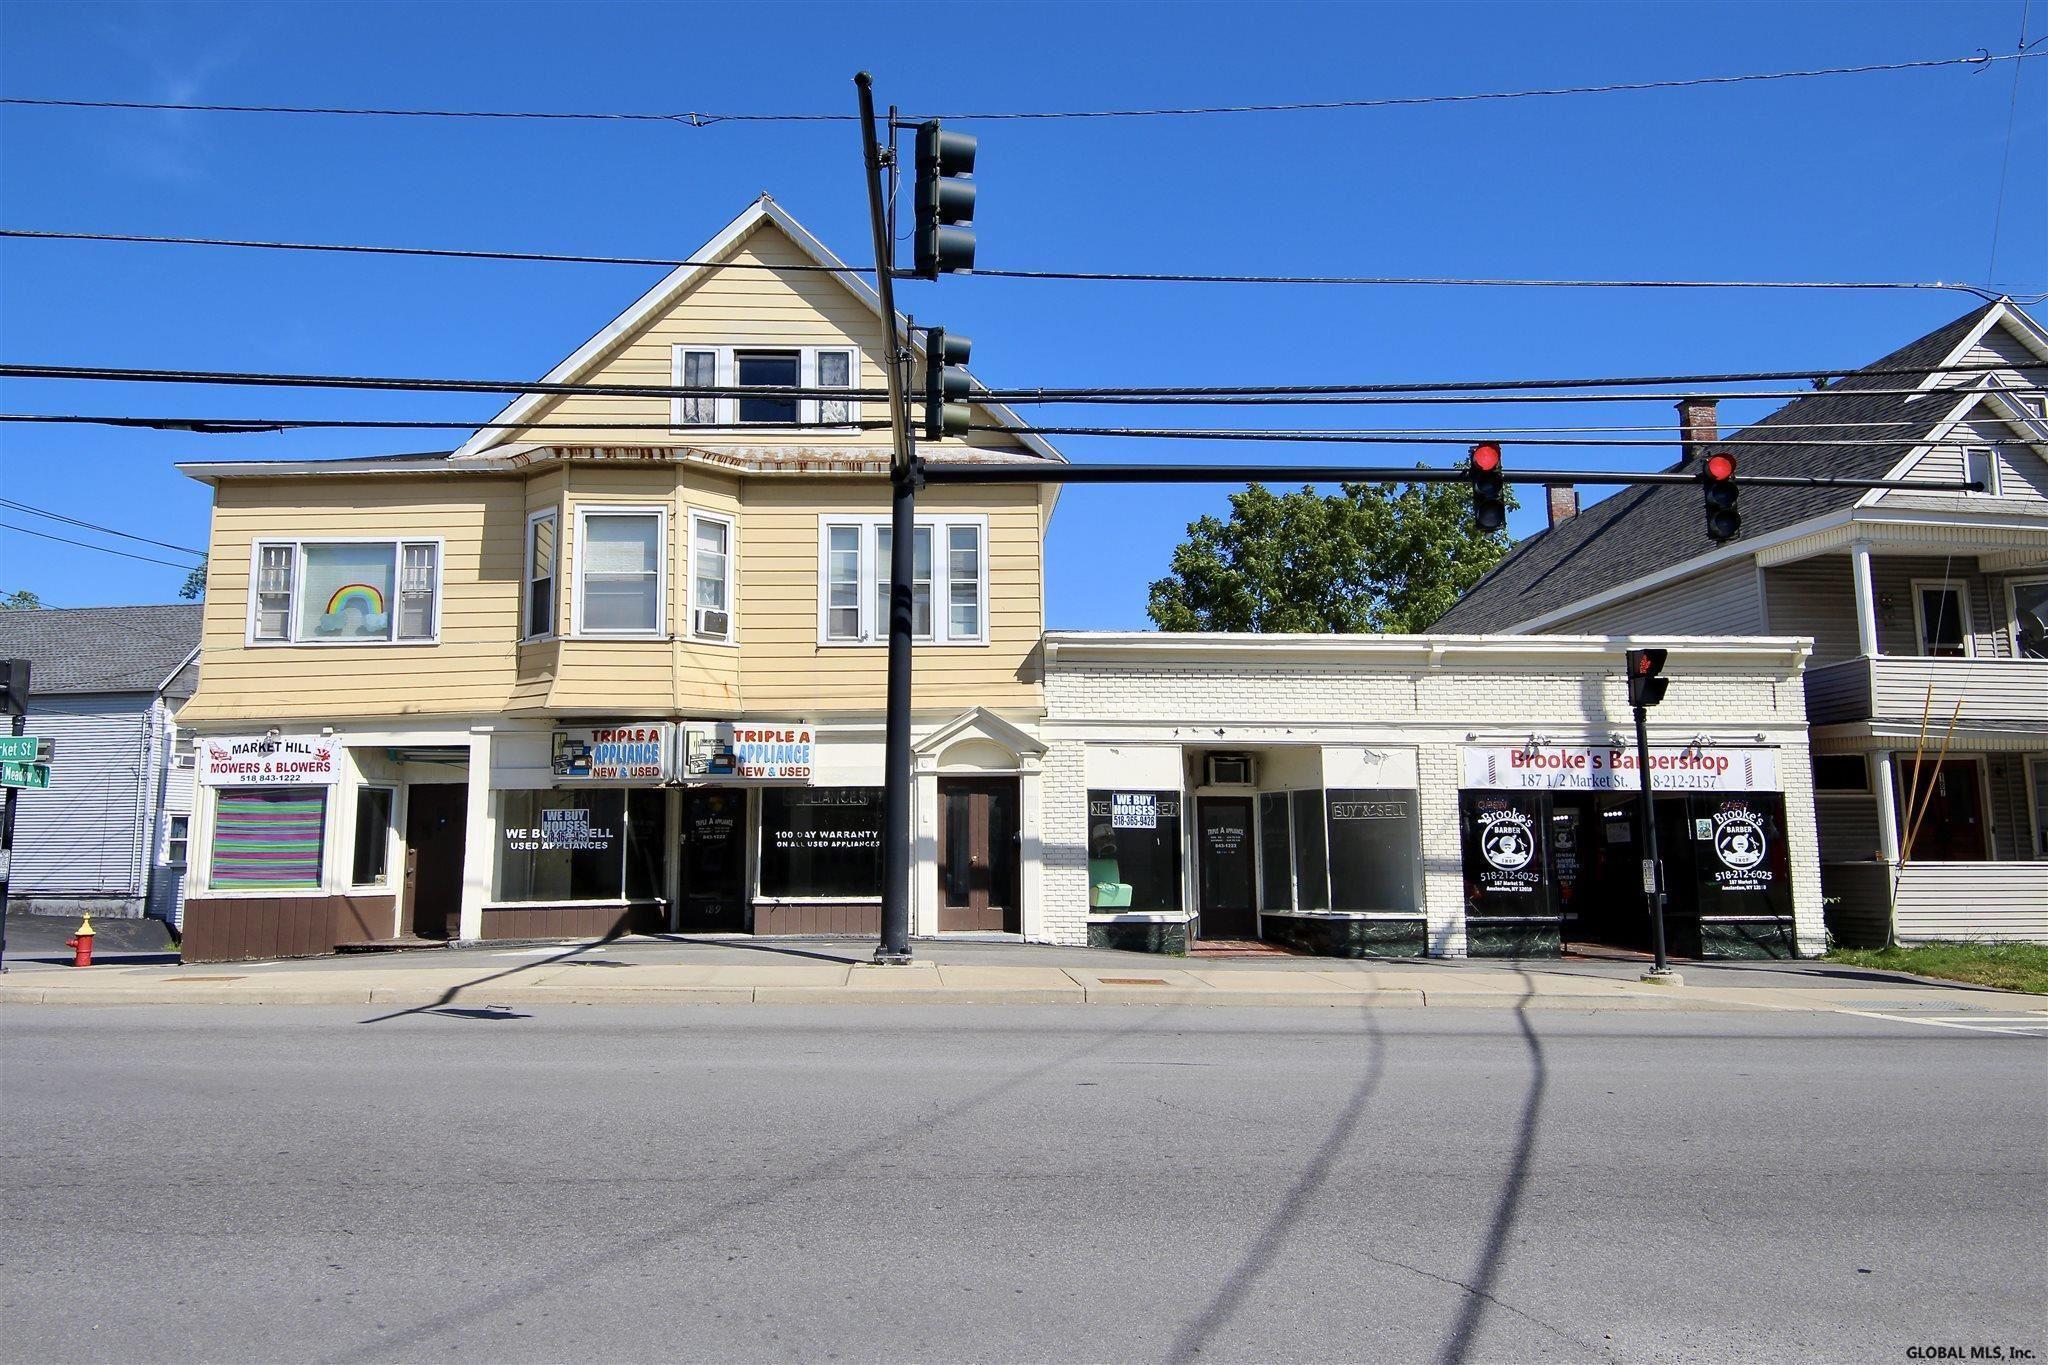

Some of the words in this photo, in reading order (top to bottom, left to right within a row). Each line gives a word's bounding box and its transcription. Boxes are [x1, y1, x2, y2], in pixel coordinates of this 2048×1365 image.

[592, 729, 646, 742] TRIPLE
[649, 729, 659, 742] A
[734, 730, 795, 742] TRIPLE
[799, 731, 811, 743] A
[21, 742, 31, 756] St
[232, 742, 282, 755] MARKET
[286, 742, 311, 754] HILL
[594, 743, 660, 765] APPLIANCE
[738, 744, 810, 764] APPLIANCE
[1510, 749, 1603, 769] Brooke's
[210, 763, 260, 773] MOWERS
[264, 763, 272, 773] &
[276, 762, 331, 773] BLOWERS
[593, 767, 617, 777] NEW
[620, 767, 628, 776] &
[631, 767, 660, 777] USED
[737, 767, 765, 776] NEW
[768, 767, 776, 776] &
[780, 767, 811, 776] USED
[5, 767, 32, 782] Meadow
[1521, 774, 1542, 787] 187
[1570, 774, 1611, 787] Market
[1614, 774, 1628, 787] St.
[1652, 775, 1717, 788] 8-212-2157
[1116, 794, 1132, 805] WE
[1133, 795, 1152, 805] BUY
[547, 810, 562, 820] WE
[564, 810, 584, 820] BUY
[1091, 803, 1111, 814] NE
[1156, 803, 1179, 816] SED
[1113, 804, 1155, 815] HOUSES
[1334, 804, 1358, 817] BUY
[1363, 804, 1375, 816] &
[1377, 804, 1405, 817] SELL
[1713, 807, 1764, 825] Brooke's
[1480, 807, 1533, 828] Brooke's
[506, 829, 527, 838] WE
[579, 828, 614, 838] SELL
[543, 821, 587, 832] HOUSES
[775, 831, 793, 839] 100
[510, 842, 539, 850] USED
[541, 841, 608, 849] APPLIANCES
[1480, 871, 1540, 882] 518-212-6025
[1715, 870, 1772, 881] 518-212-6025
